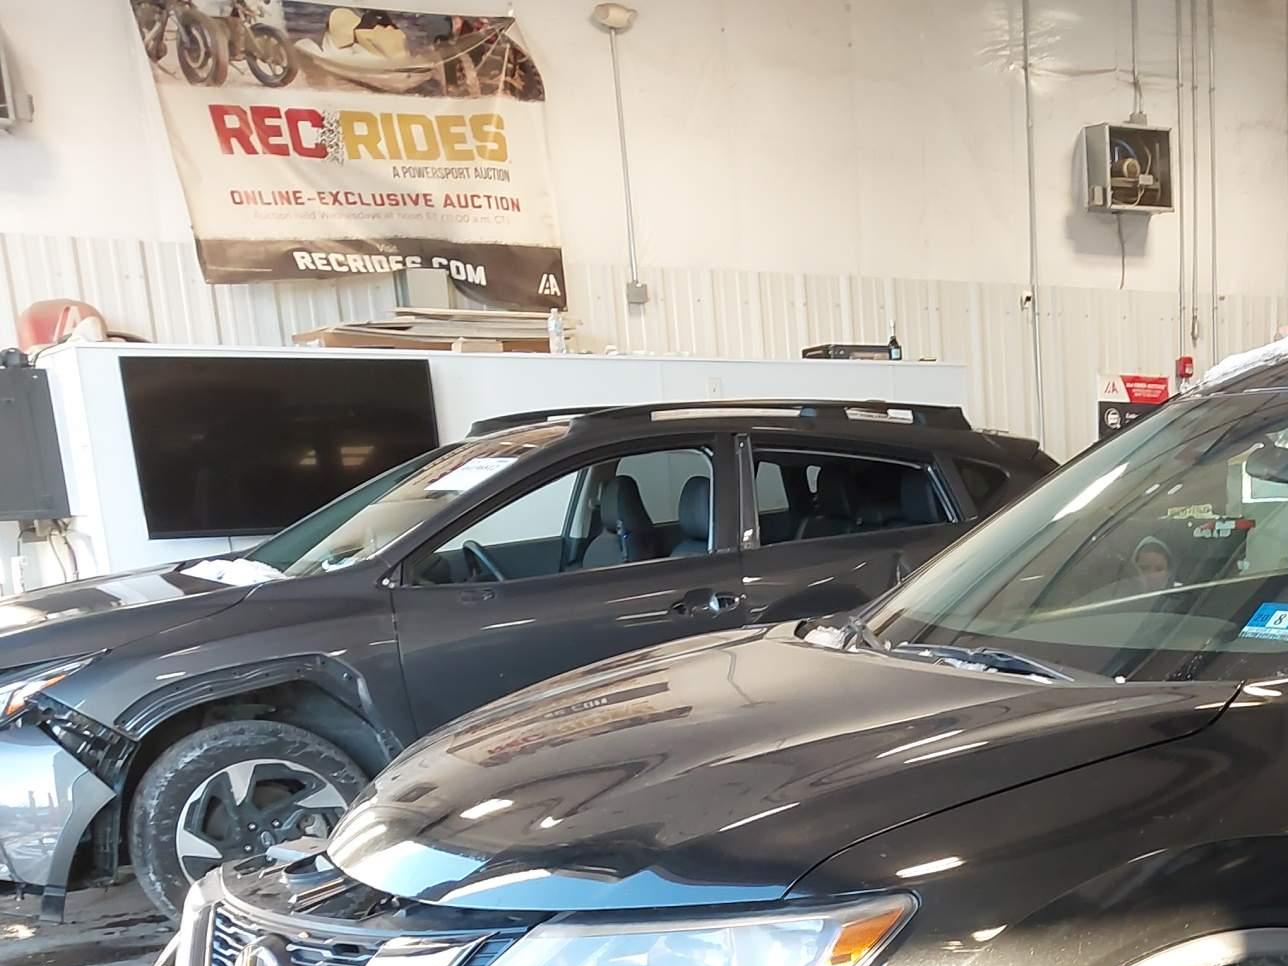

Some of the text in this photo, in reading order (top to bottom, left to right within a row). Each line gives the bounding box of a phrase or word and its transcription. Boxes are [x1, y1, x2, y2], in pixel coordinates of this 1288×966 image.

[208, 105, 508, 162] REC RIDES
[393, 166, 511, 182] A POWERSPORT AUCTION
[230, 190, 521, 212] ONLINE-EXCLUSIVE AUCTION
[292, 251, 487, 286] RECRIDESCOM
[1273, 613, 1287, 626] 8
